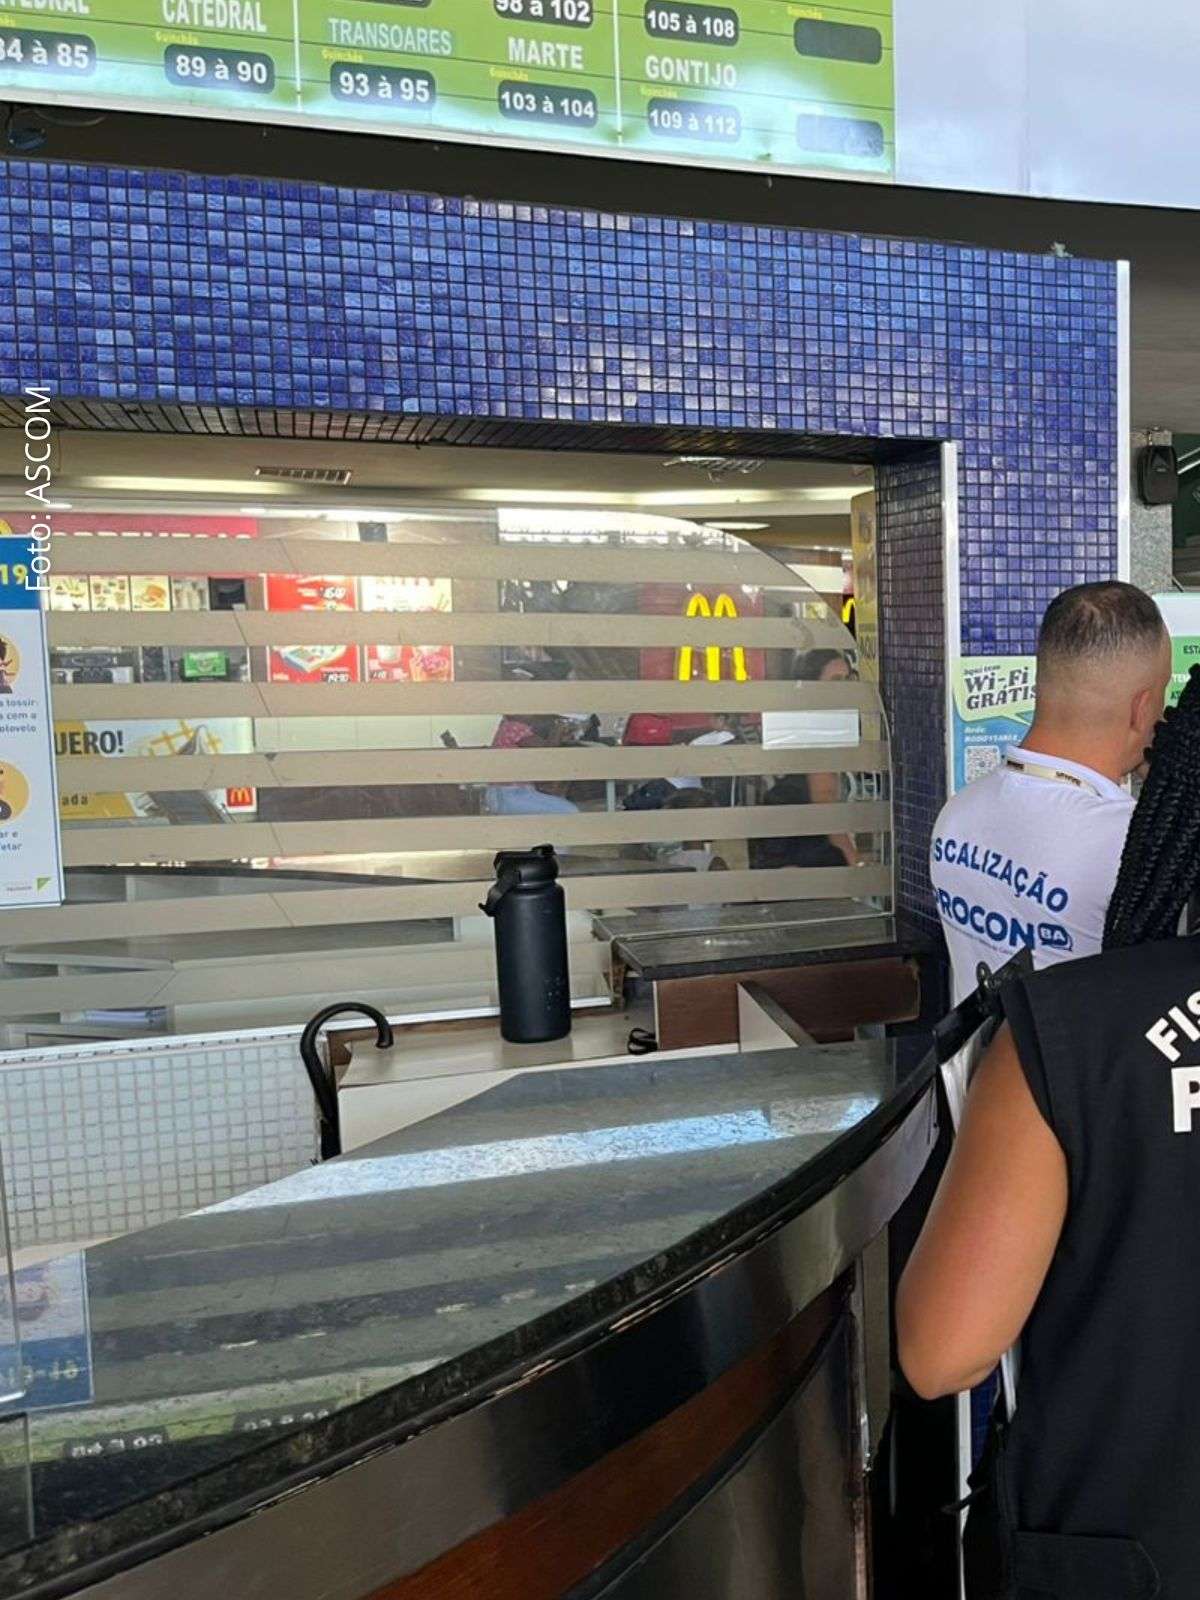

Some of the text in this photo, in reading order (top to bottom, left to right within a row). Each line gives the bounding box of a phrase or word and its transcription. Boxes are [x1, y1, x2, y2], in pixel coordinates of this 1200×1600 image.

[162, 0, 267, 33] CATEDRAL
[550, 0, 592, 23] 102
[647, 10, 735, 38] 105 à 108
[328, 17, 452, 56] TRANSOARES
[31, 39, 49, 66] à
[56, 42, 90, 70] 85
[507, 36, 584, 71] MARTE
[175, 54, 268, 85] 89 à 90
[645, 54, 737, 87] GONTIJO
[338, 71, 431, 103] 93 à 95
[501, 90, 595, 119] 103 à 104
[650, 109, 683, 130] 109
[704, 115, 737, 136] 112
[965, 666, 1029, 693] Wi-Fi
[54, 730, 124, 756] UERO!
[934, 837, 1069, 912] SCALIZAÇÃO
[937, 887, 1035, 950] ROCON
